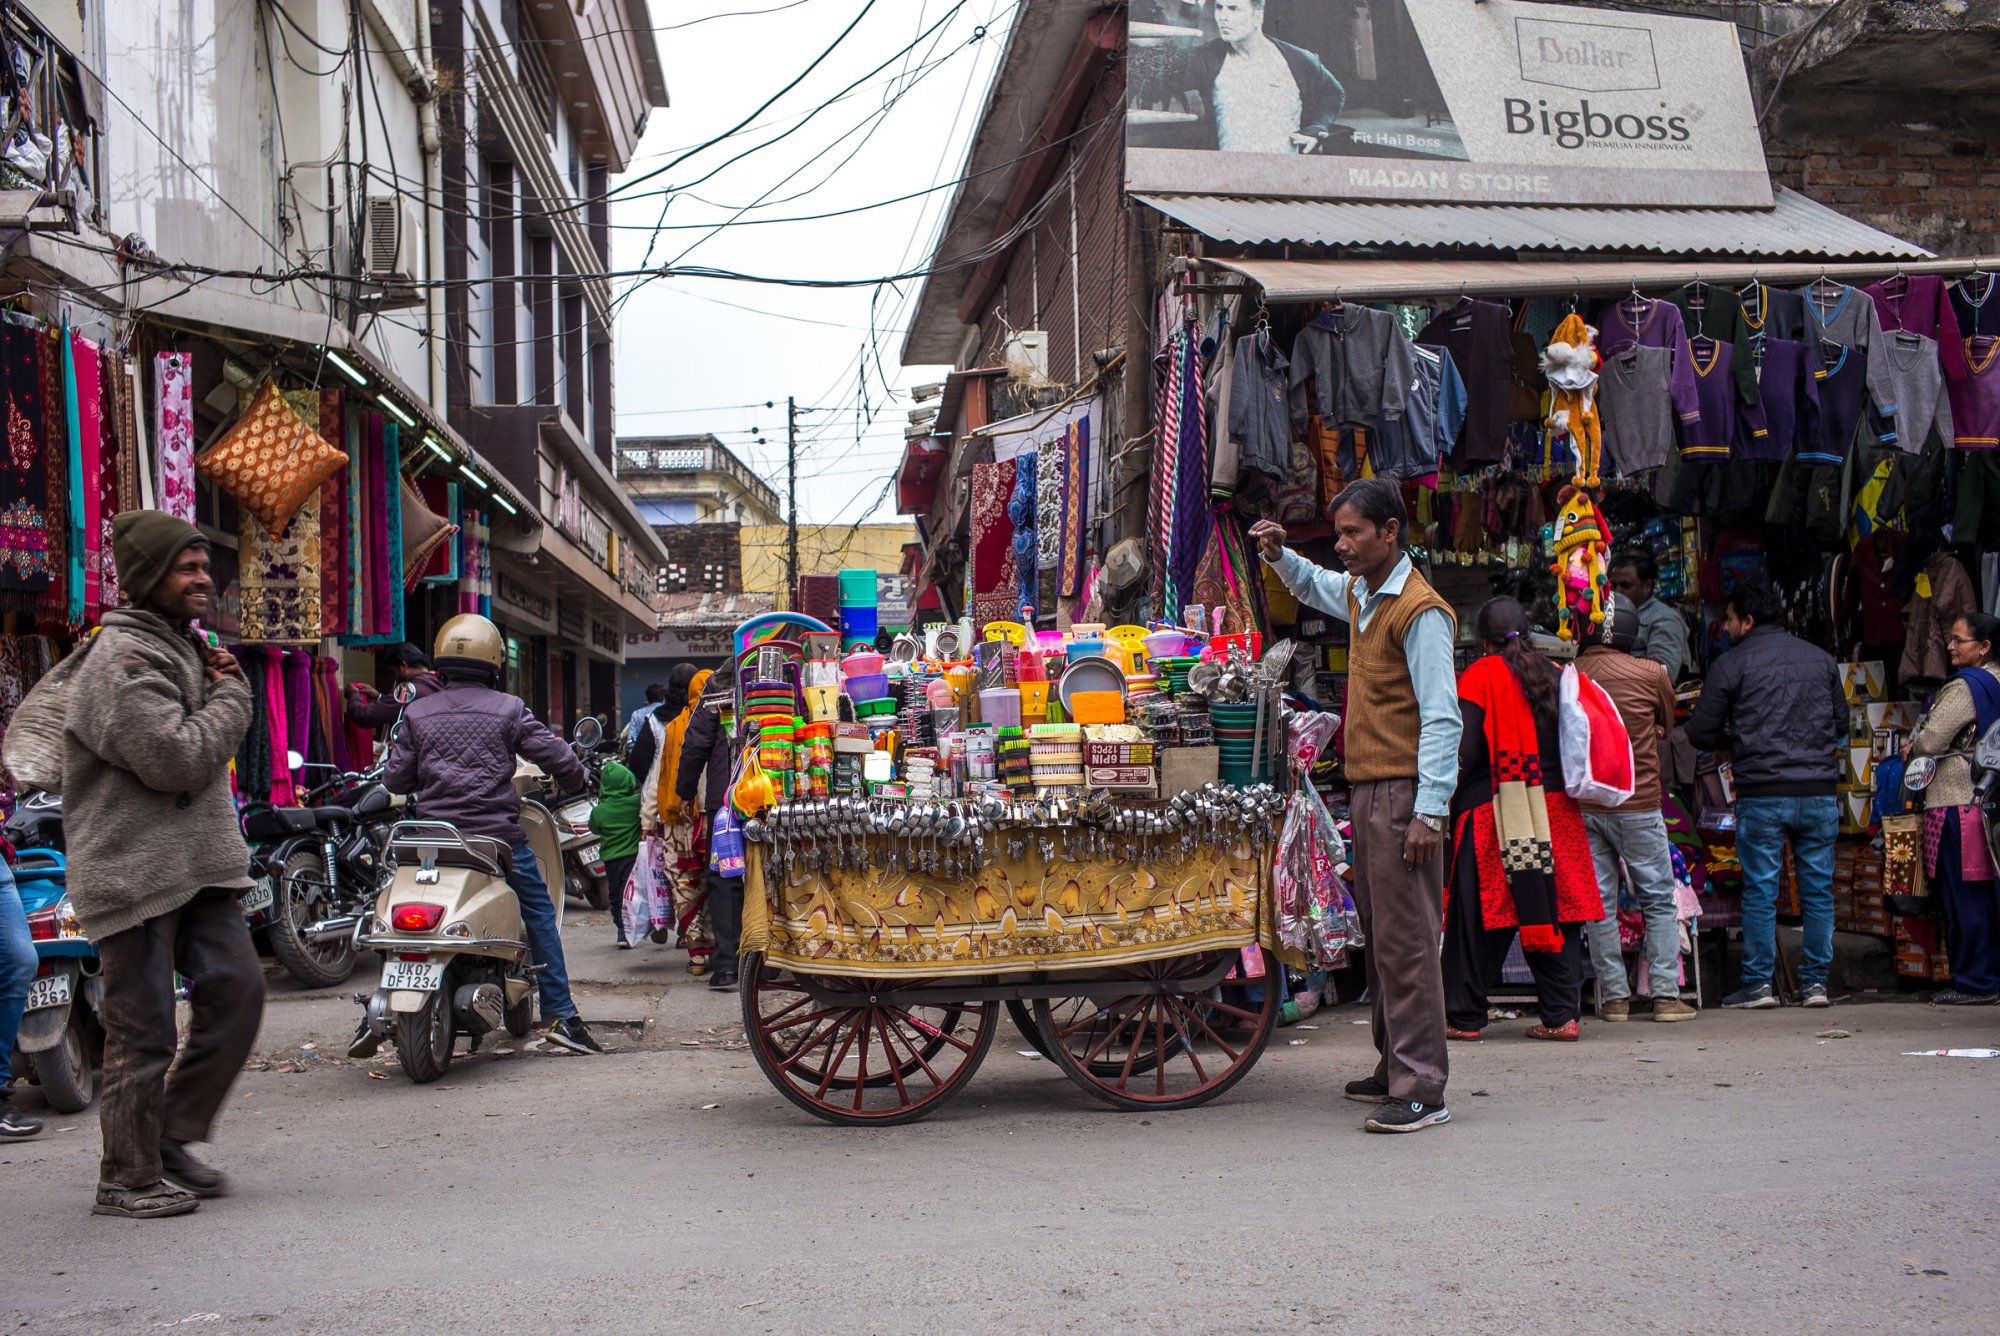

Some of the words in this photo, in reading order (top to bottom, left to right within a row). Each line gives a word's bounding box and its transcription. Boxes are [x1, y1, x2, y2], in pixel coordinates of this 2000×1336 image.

[1537, 36, 1629, 69] Dollar
[1504, 97, 1691, 149] Bigboss
[1352, 131, 1373, 144] Fit
[1376, 132, 1402, 146] Hai
[1406, 134, 1441, 148] Boss
[1586, 140, 1633, 149] PREMIUM
[1635, 142, 1694, 152] INNERWEAR
[1347, 167, 1449, 189] MADAN
[1458, 172, 1551, 193] STORE
[968, 728, 987, 736] NOA
[1091, 745, 1118, 754] 12PCS
[1091, 754, 1118, 764] 6PIN
[398, 963, 432, 976] UK07
[29, 978, 55, 995] K07
[387, 975, 439, 988] DF1234
[28, 989, 69, 1008] 8262
